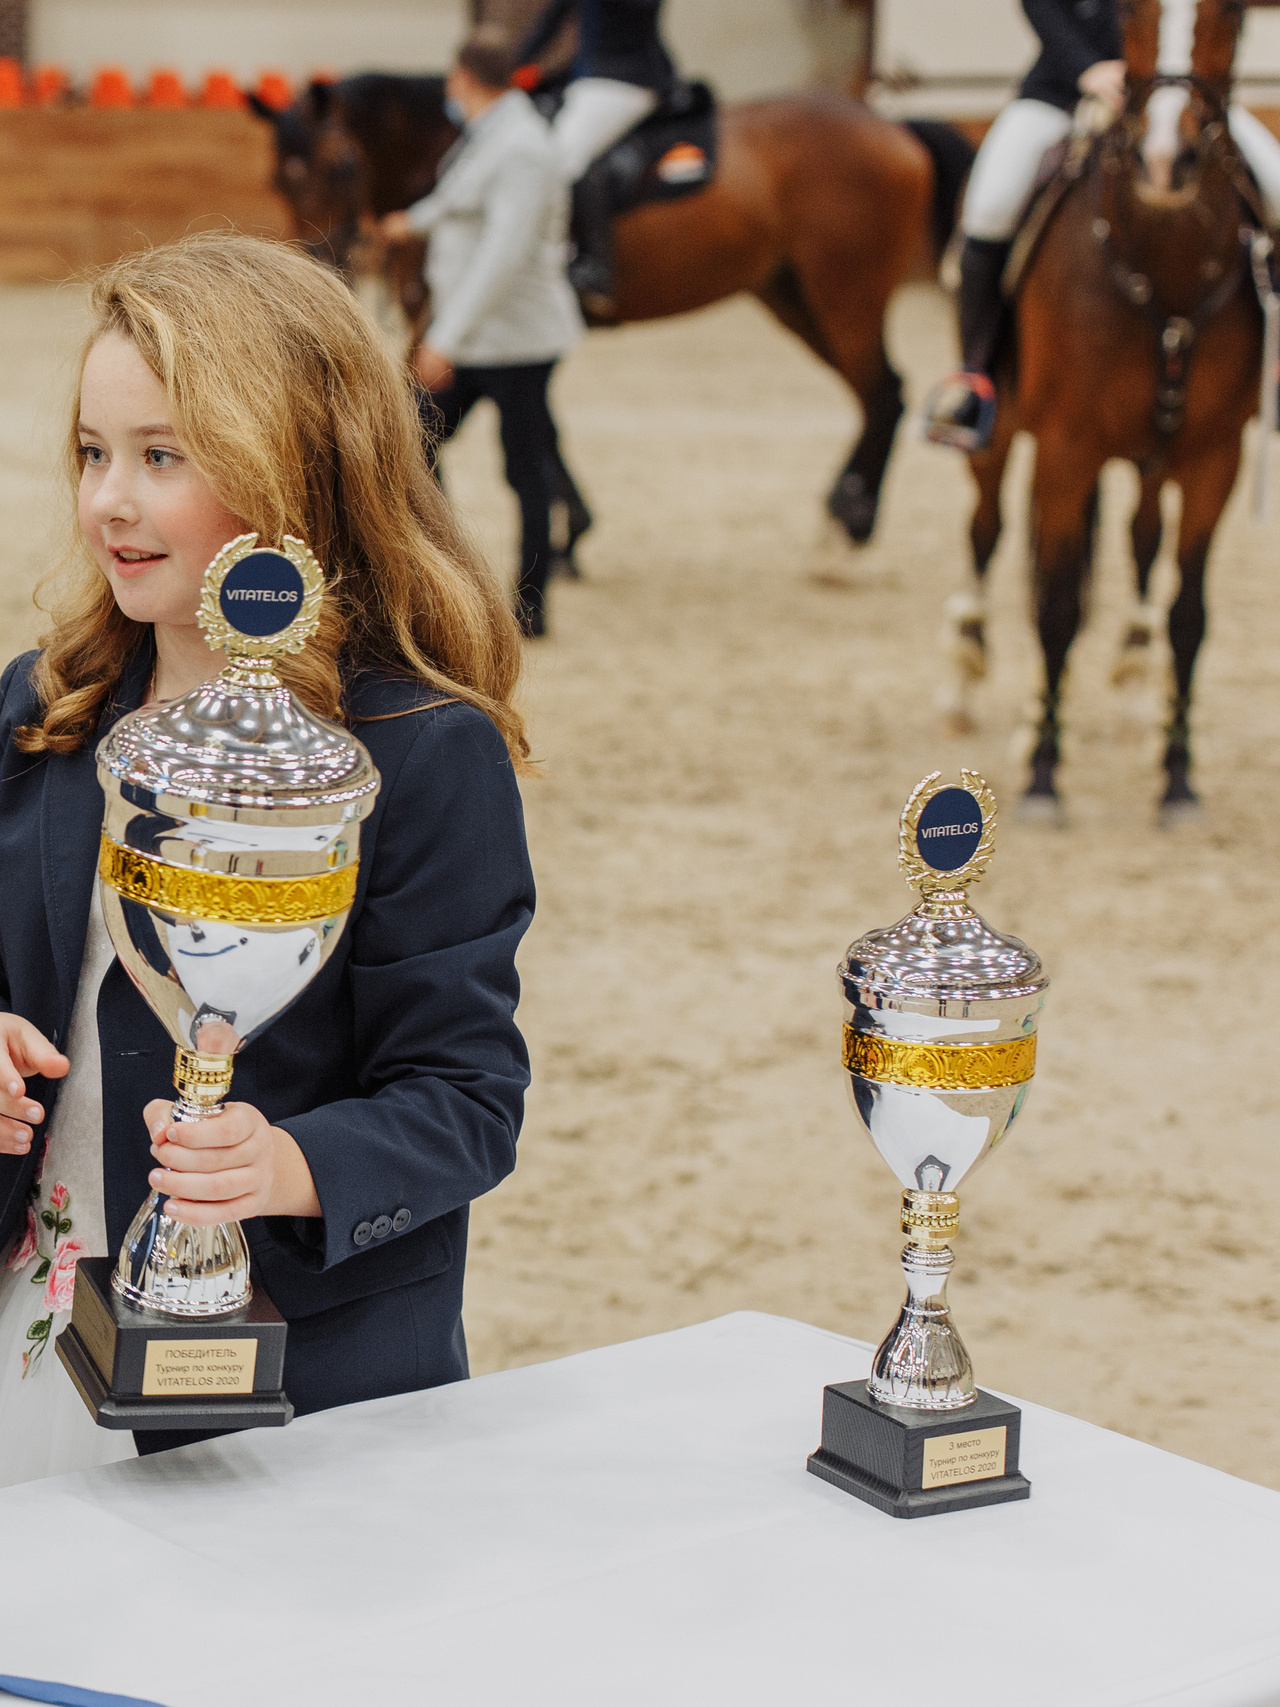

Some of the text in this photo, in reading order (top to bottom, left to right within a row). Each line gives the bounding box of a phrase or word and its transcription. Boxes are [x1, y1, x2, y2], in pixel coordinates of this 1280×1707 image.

[226, 589, 298, 602] VITATELOS
[921, 822, 979, 839] VITATELOS
[165, 1349, 237, 1359] ПОБЕДИТЕЛЬ
[155, 1364, 190, 1374] Турнир
[207, 1364, 244, 1373] конкуру
[157, 1376, 240, 1386] VITATELOS 2020
[949, 1439, 981, 1450] 3 место
[929, 1449, 999, 1468] Турнир по конкуру
[931, 1461, 996, 1480] VITATELOS 2020
